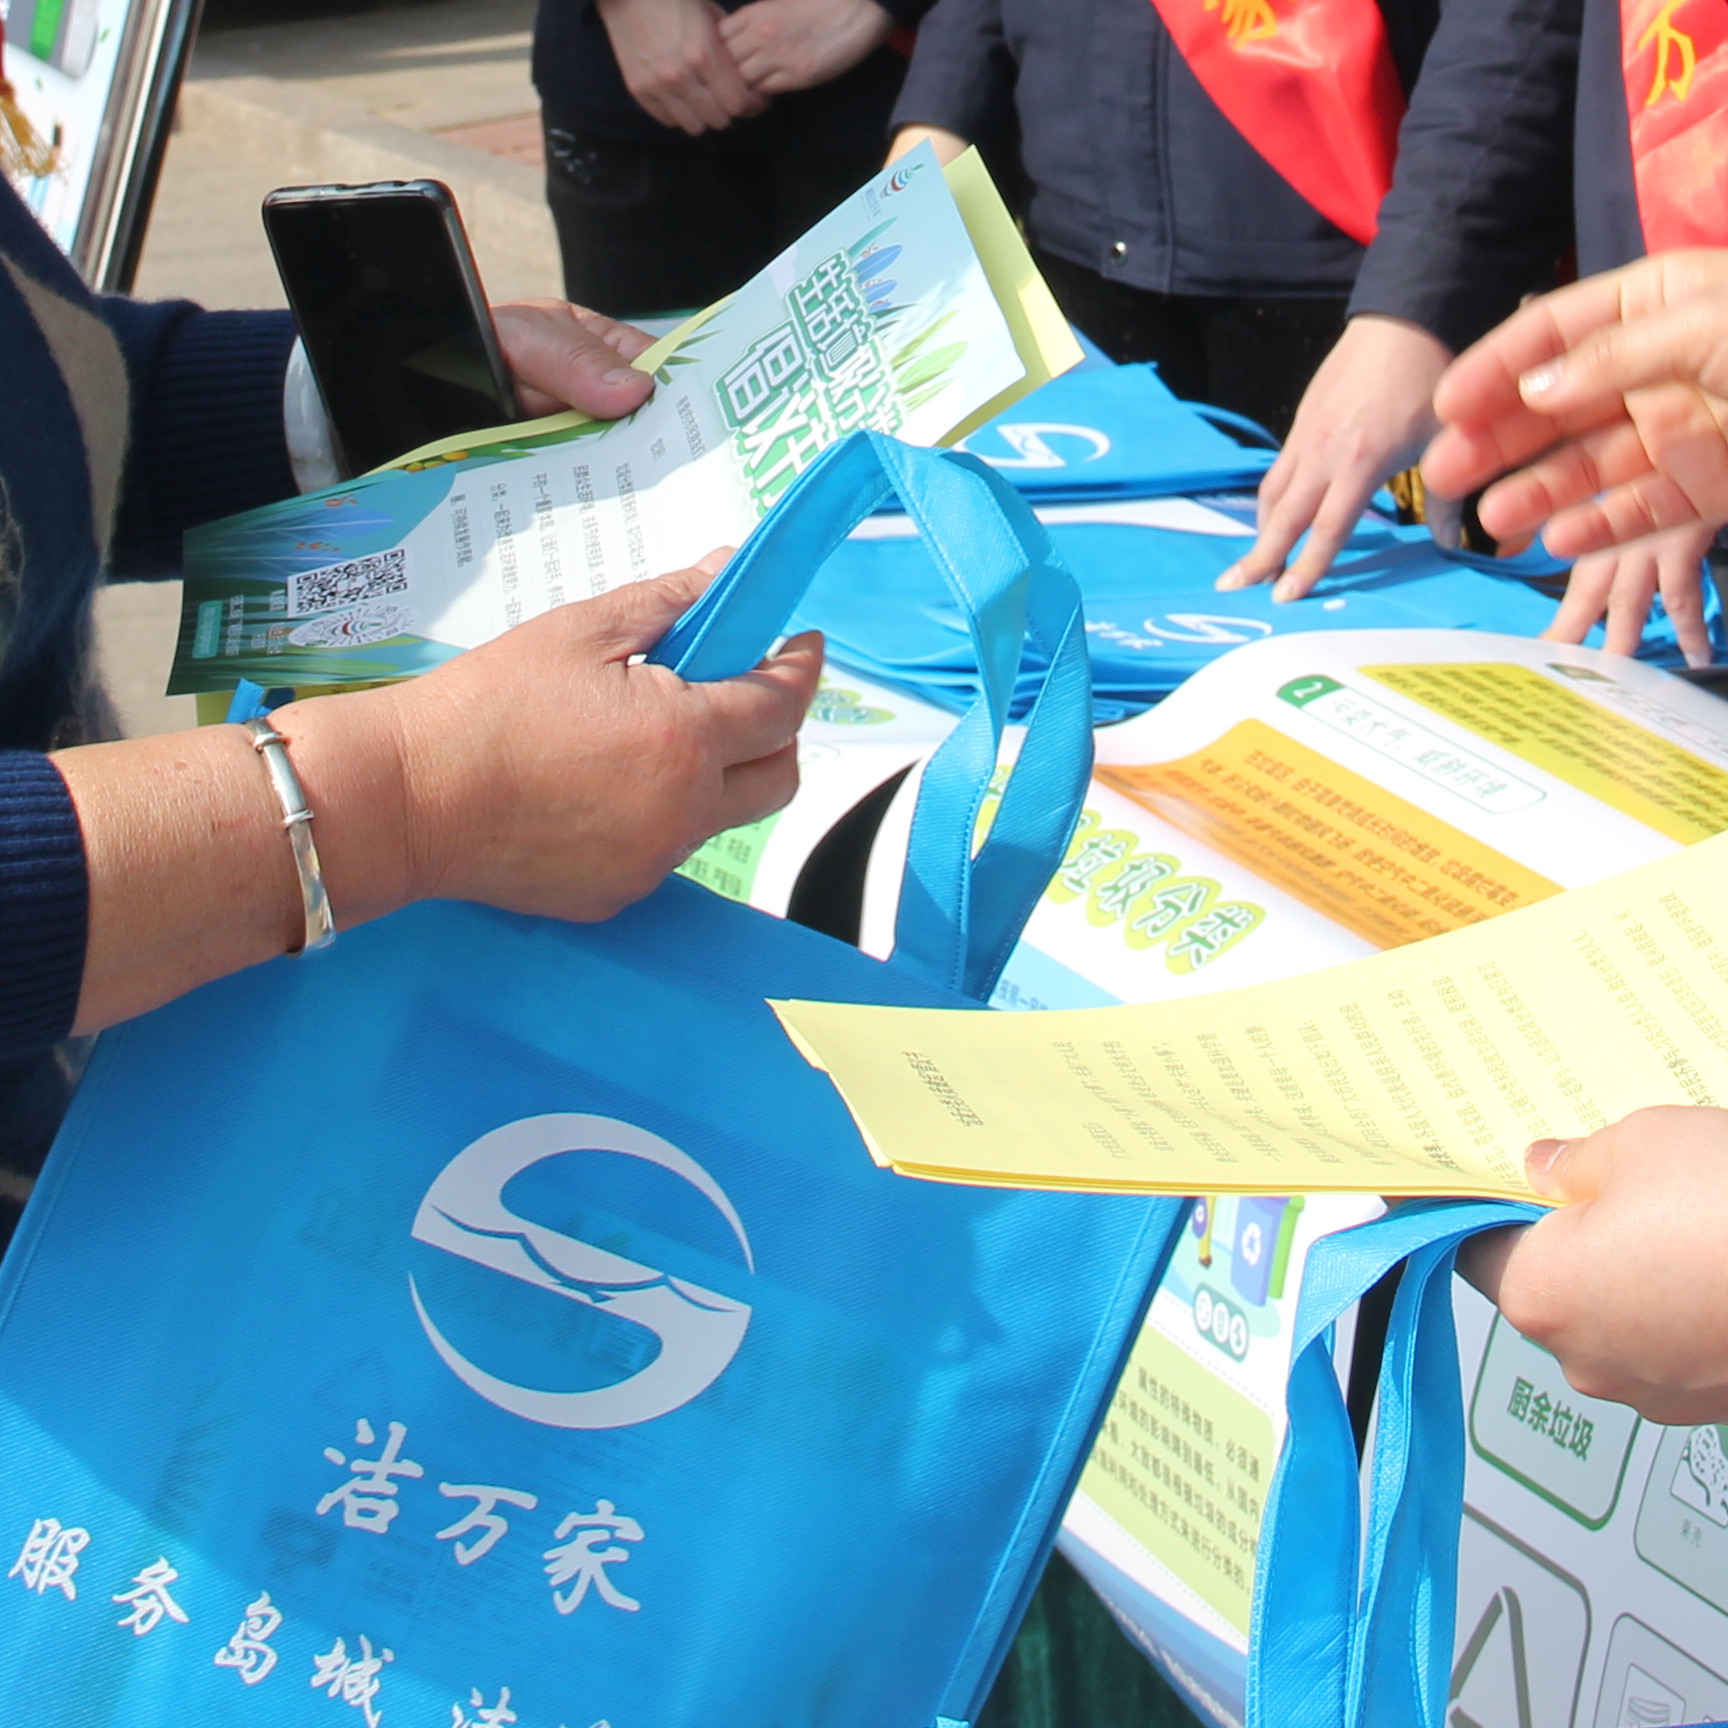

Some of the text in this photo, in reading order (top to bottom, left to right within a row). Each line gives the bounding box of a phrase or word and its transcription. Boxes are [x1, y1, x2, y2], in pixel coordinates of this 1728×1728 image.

[1506, 1375, 1595, 1462] 厨余垃圾
[313, 1418, 646, 1616] 洁万家
